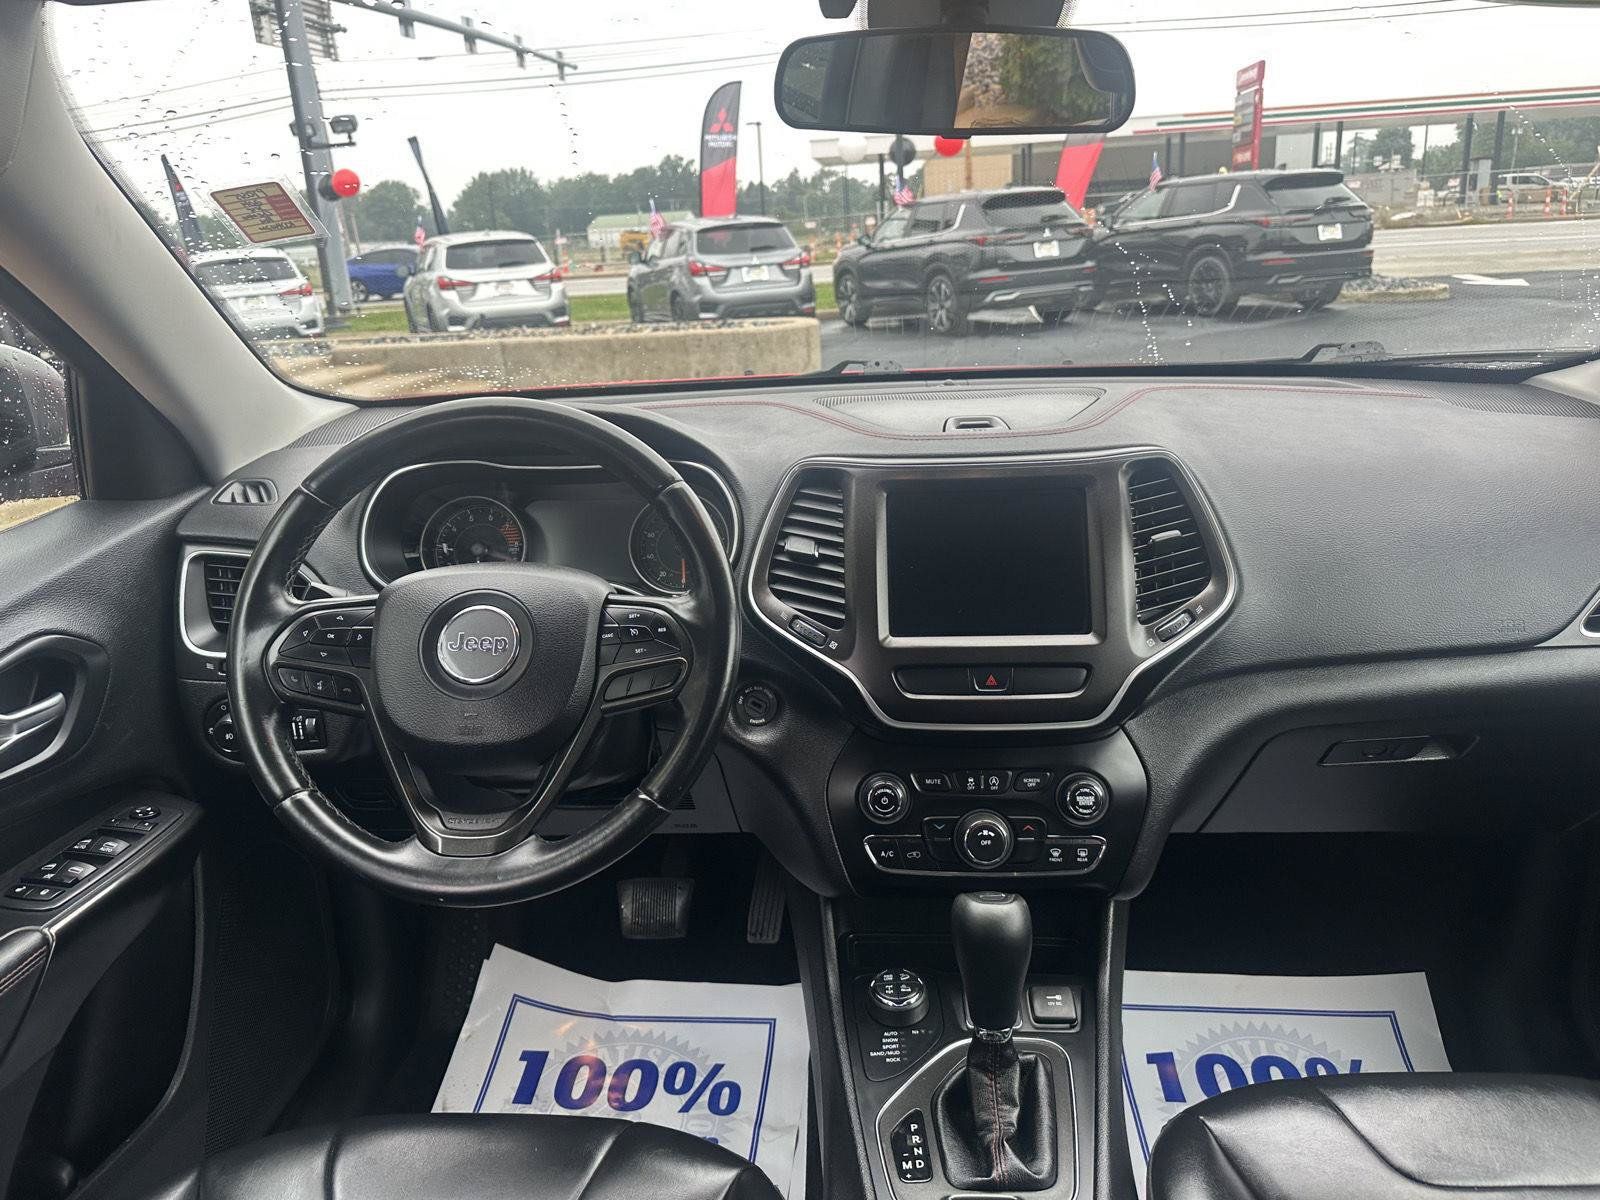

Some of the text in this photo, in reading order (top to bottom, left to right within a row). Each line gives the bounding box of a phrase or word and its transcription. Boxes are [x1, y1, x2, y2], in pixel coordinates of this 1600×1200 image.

[447, 631, 509, 656] Jeep
[880, 850, 895, 859] A/C
[511, 1049, 742, 1117] 100%
[910, 1123, 918, 1132] P
[911, 1135, 921, 1144] R
[913, 1146, 923, 1156] N
[902, 1160, 913, 1170] M
[915, 1159, 925, 1169] D
